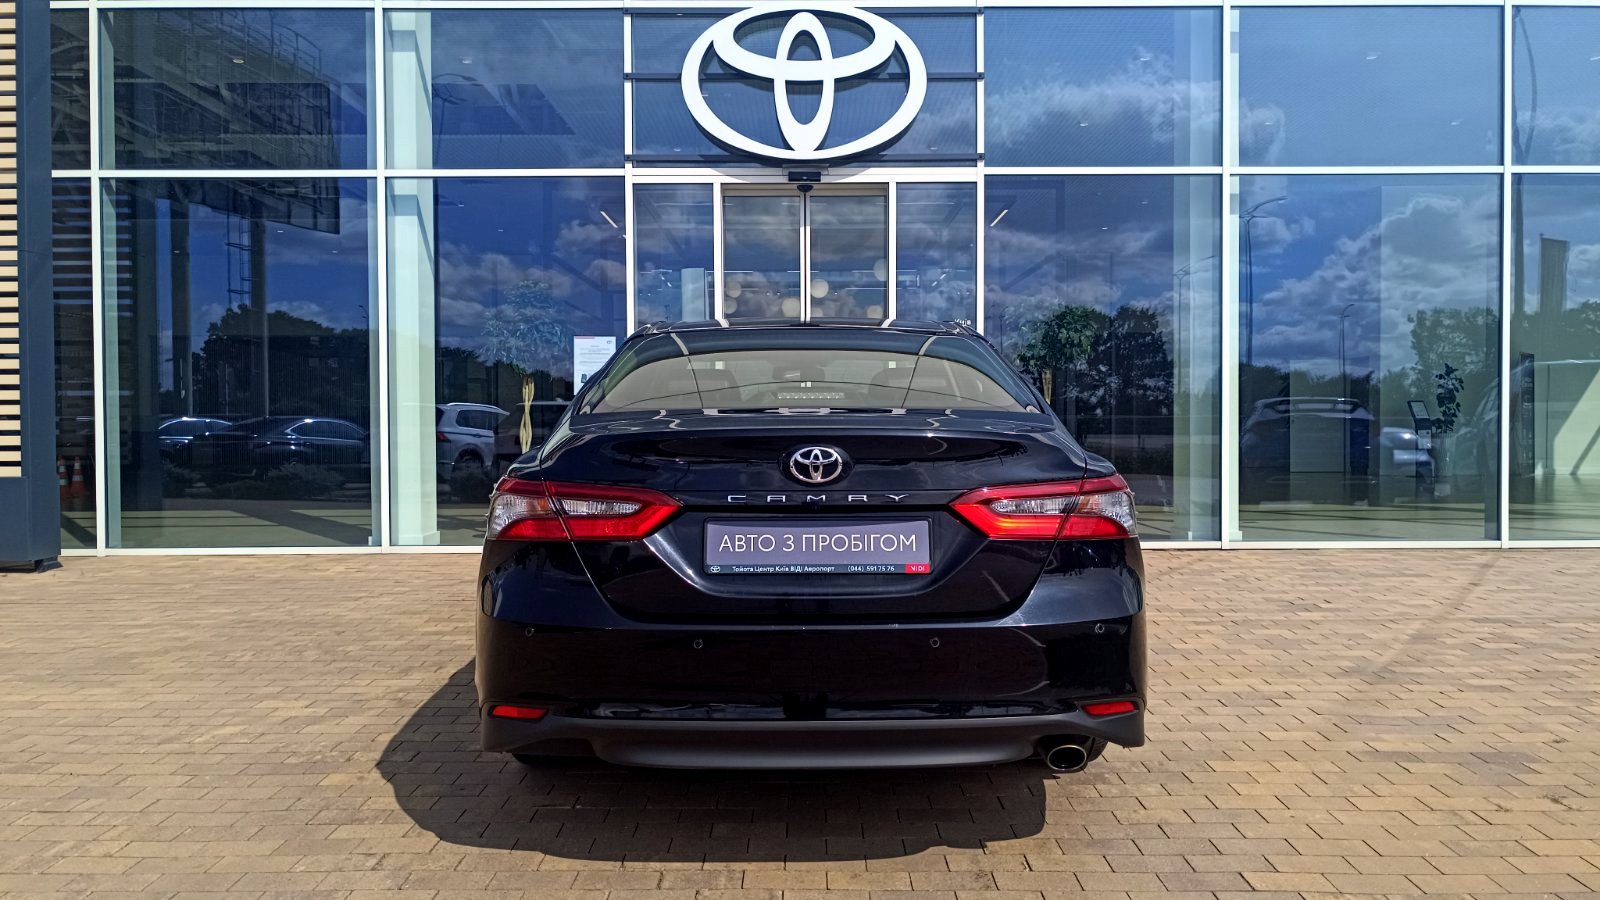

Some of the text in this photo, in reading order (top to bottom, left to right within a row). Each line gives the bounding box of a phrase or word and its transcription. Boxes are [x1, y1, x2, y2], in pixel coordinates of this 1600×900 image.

[727, 494, 909, 503] CAMRY
[719, 534, 916, 553] АВТО З ПРОБІГОМ
[732, 565, 754, 573] Тойота
[754, 565, 775, 574] Центр
[775, 564, 789, 573] Київ
[804, 565, 835, 574] Аеропорт
[847, 565, 864, 573] (044)
